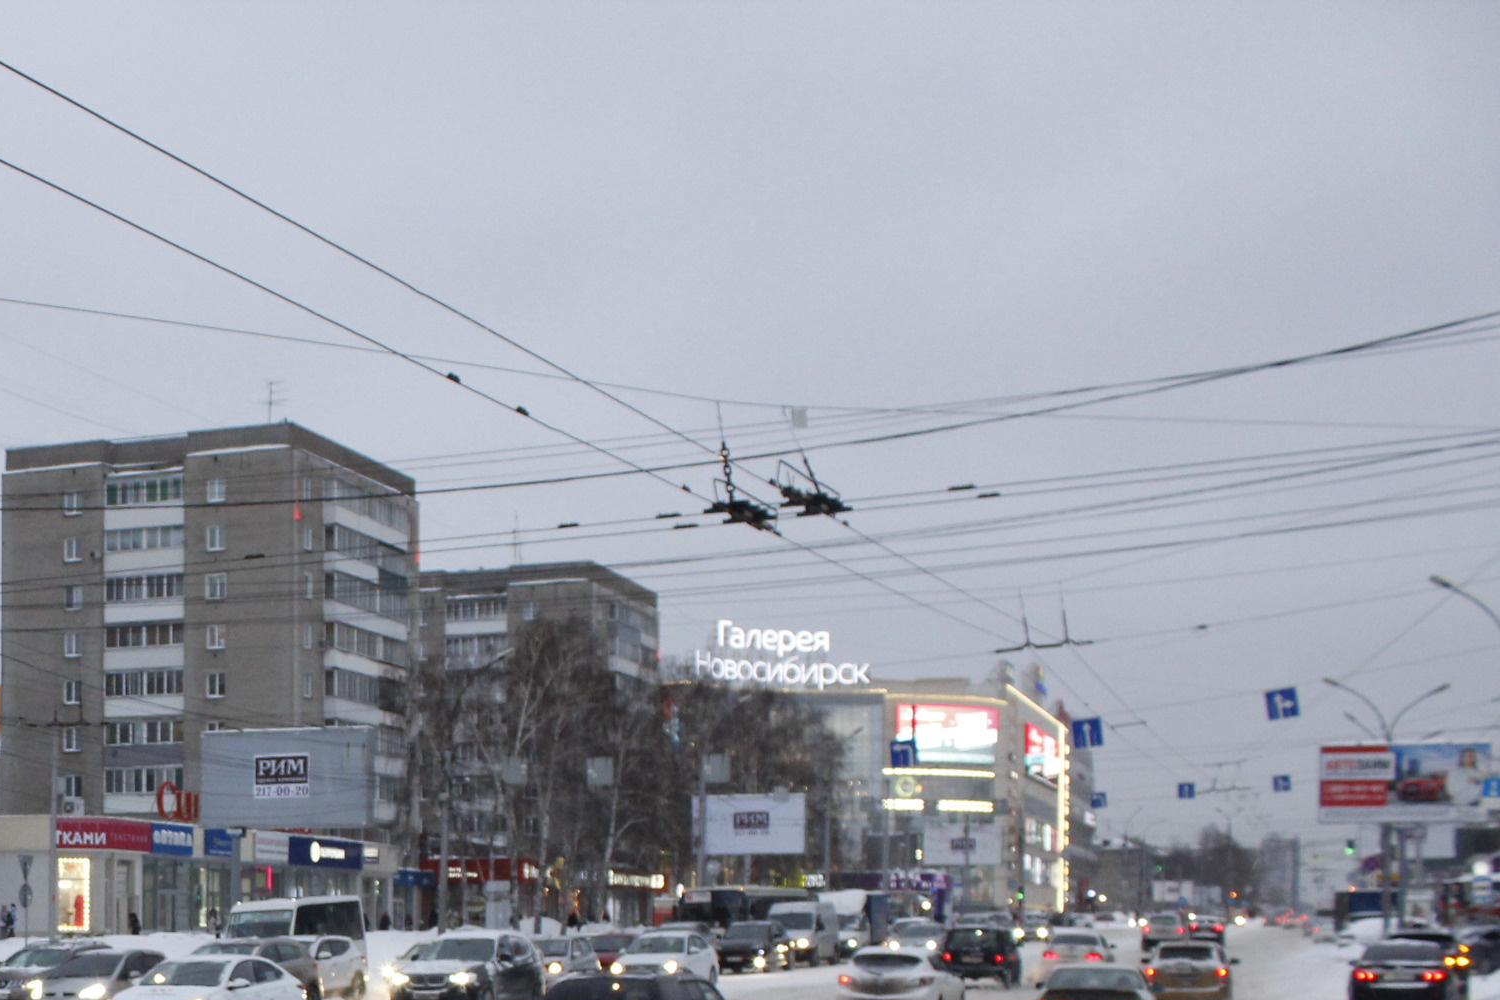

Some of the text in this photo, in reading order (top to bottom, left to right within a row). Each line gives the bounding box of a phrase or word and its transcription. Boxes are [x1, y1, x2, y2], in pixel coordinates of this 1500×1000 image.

[718, 619, 831, 658] Галерея
[695, 650, 870, 691] Новосибирск
[258, 759, 304, 776] РИМ
[256, 786, 308, 796] 217-00-20
[56, 830, 107, 846] ТКАНИ
